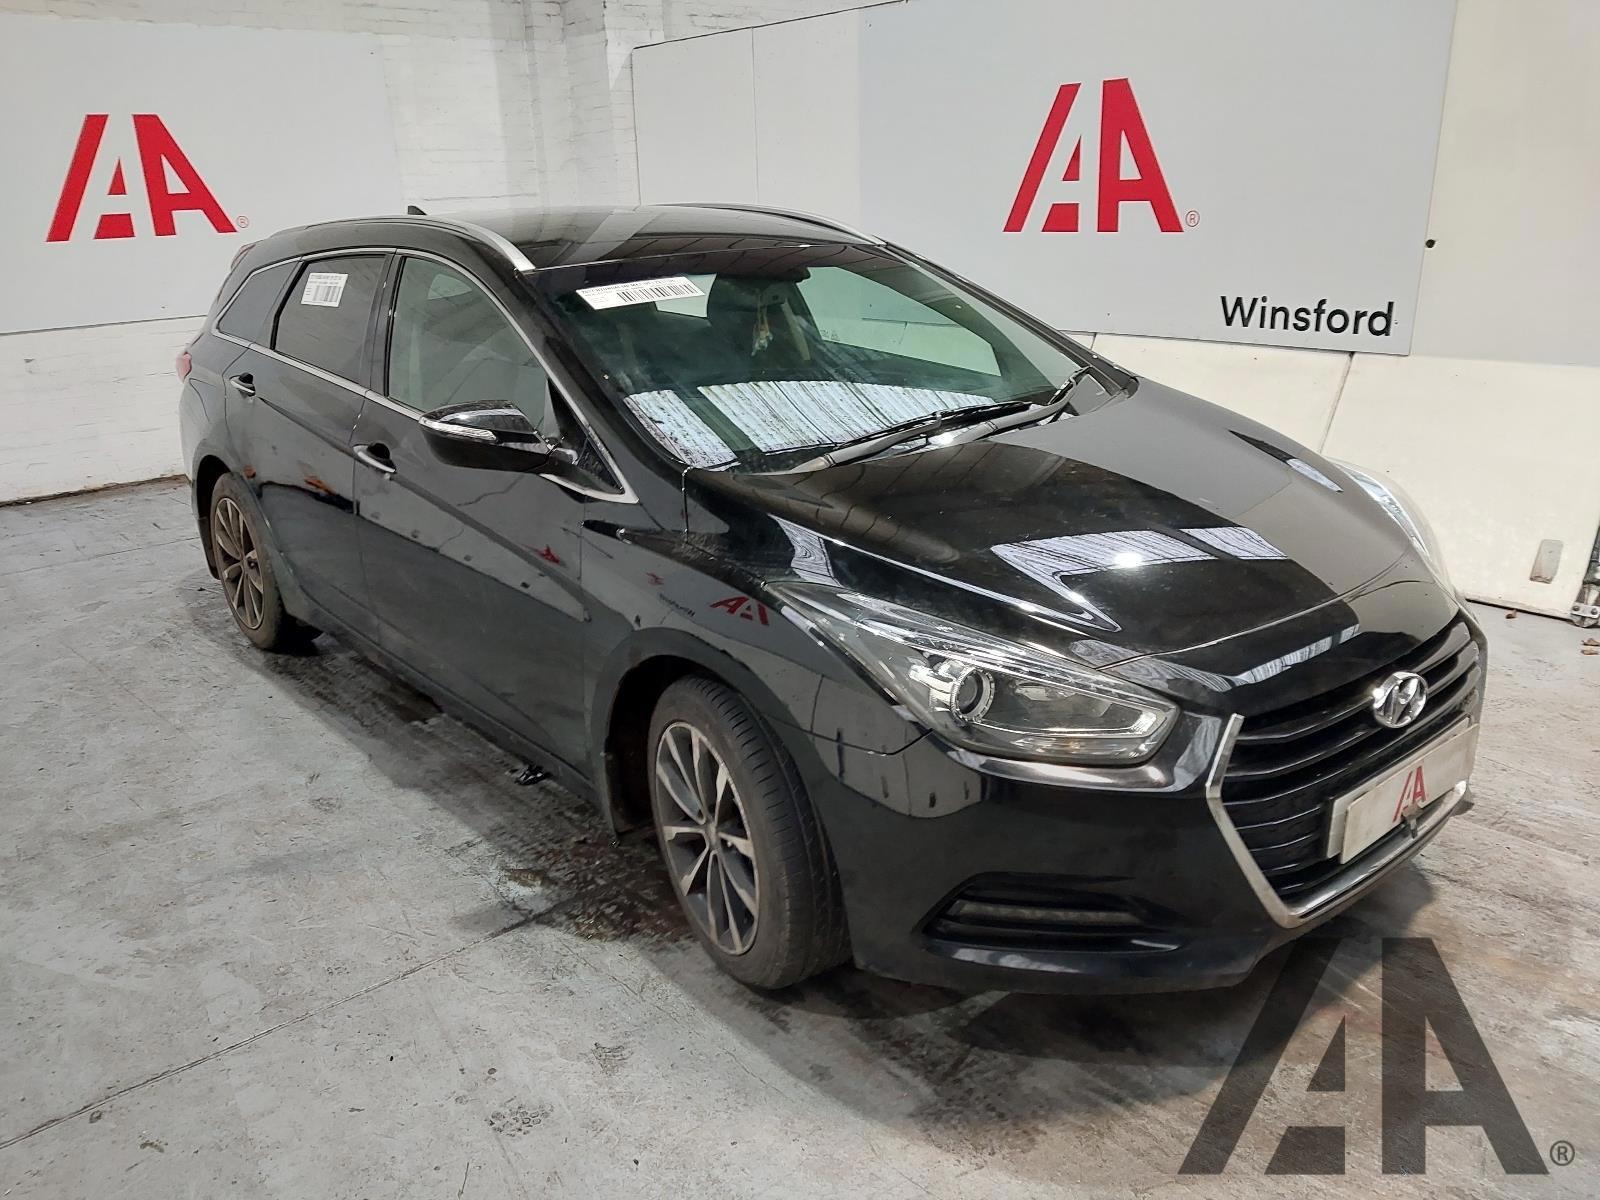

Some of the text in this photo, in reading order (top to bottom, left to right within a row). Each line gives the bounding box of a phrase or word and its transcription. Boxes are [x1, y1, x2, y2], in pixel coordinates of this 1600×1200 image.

[46, 114, 238, 242] AA
[1002, 78, 1185, 233] AA
[1220, 295, 1395, 337] Winsford
